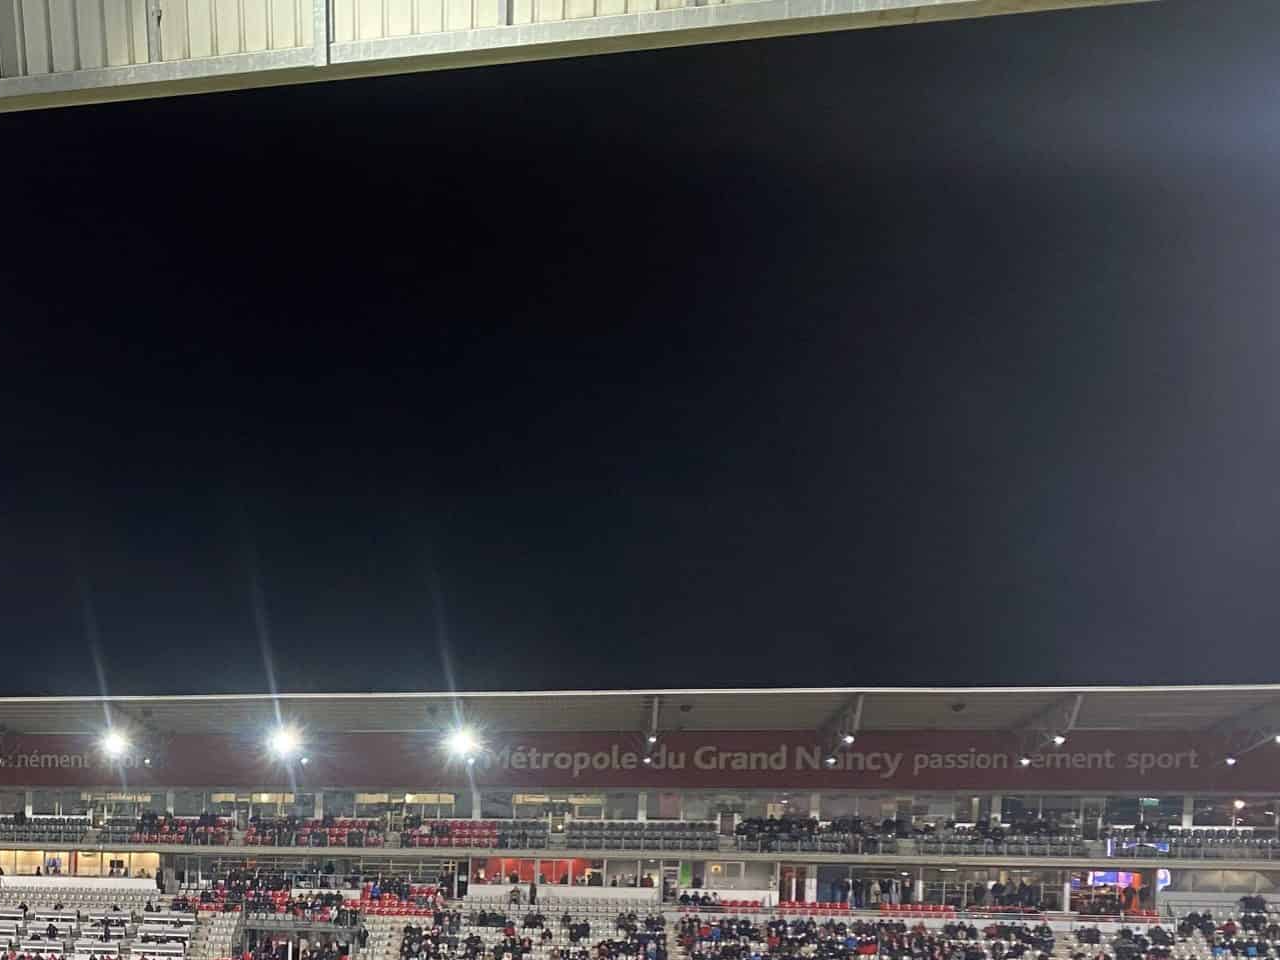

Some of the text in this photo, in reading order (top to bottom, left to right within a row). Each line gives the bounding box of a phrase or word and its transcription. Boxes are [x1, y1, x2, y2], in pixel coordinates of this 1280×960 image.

[649, 744, 686, 769] du
[693, 745, 787, 770] Grand
[1126, 746, 1201, 775] sport
